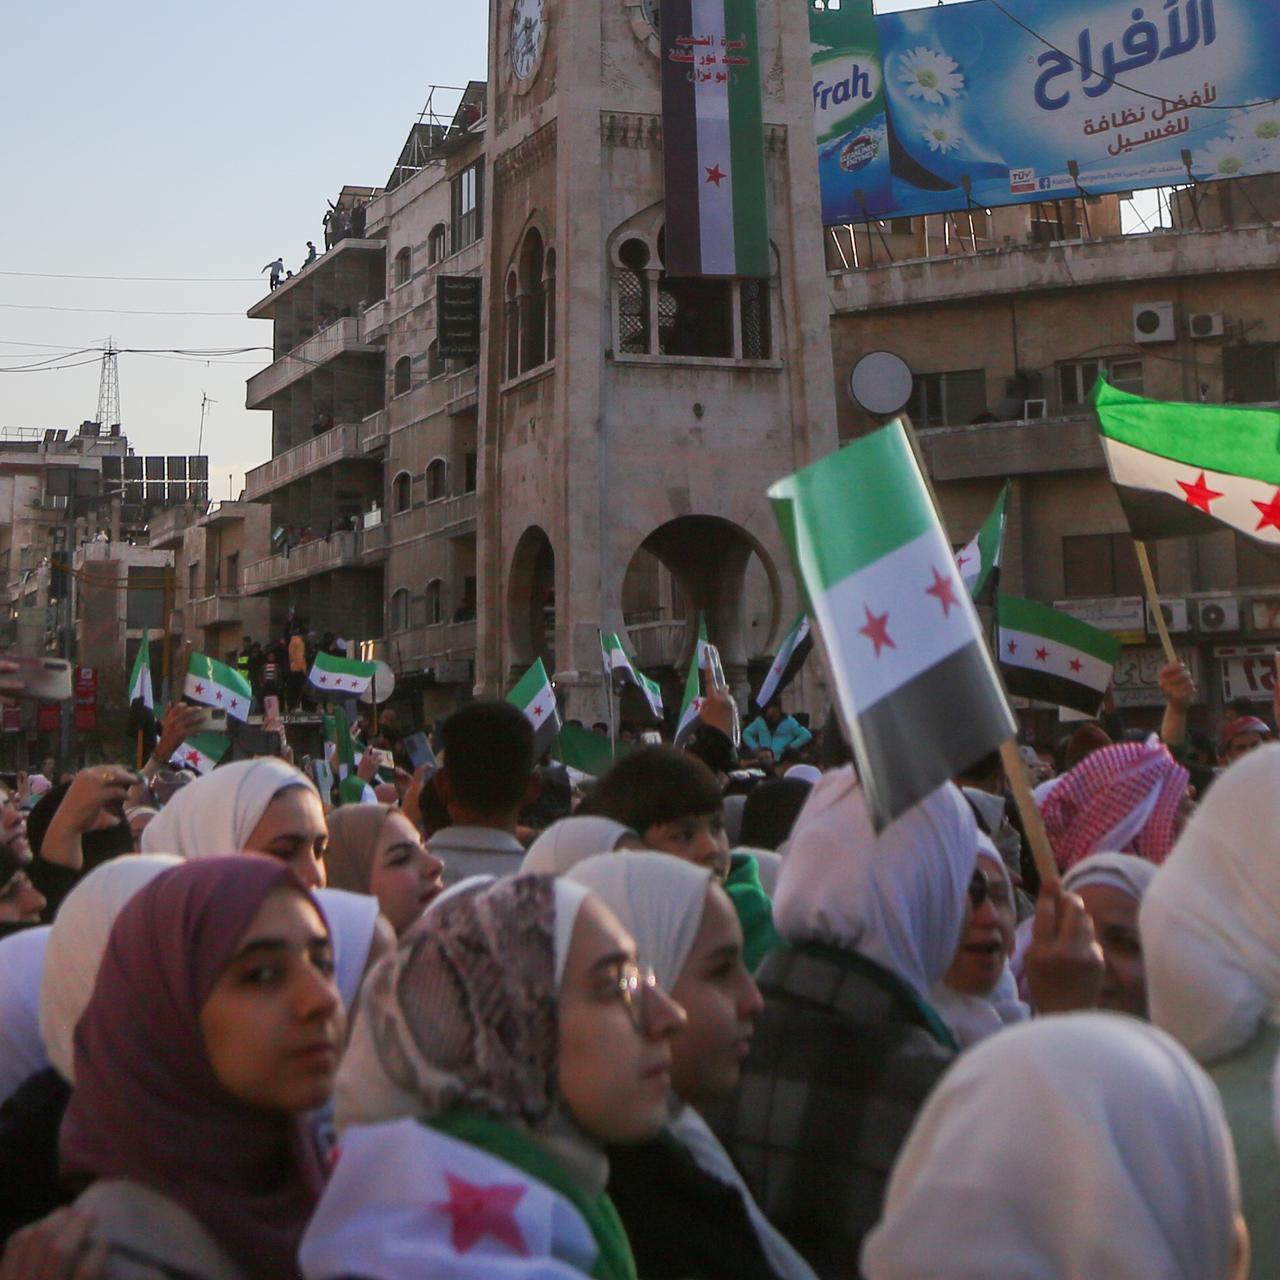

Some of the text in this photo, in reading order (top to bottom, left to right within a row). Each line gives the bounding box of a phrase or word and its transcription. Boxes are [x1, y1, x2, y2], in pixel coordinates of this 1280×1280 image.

[1083, 81, 1217, 136] لأفضل نظافة
[1107, 115, 1190, 156] للغسيل
